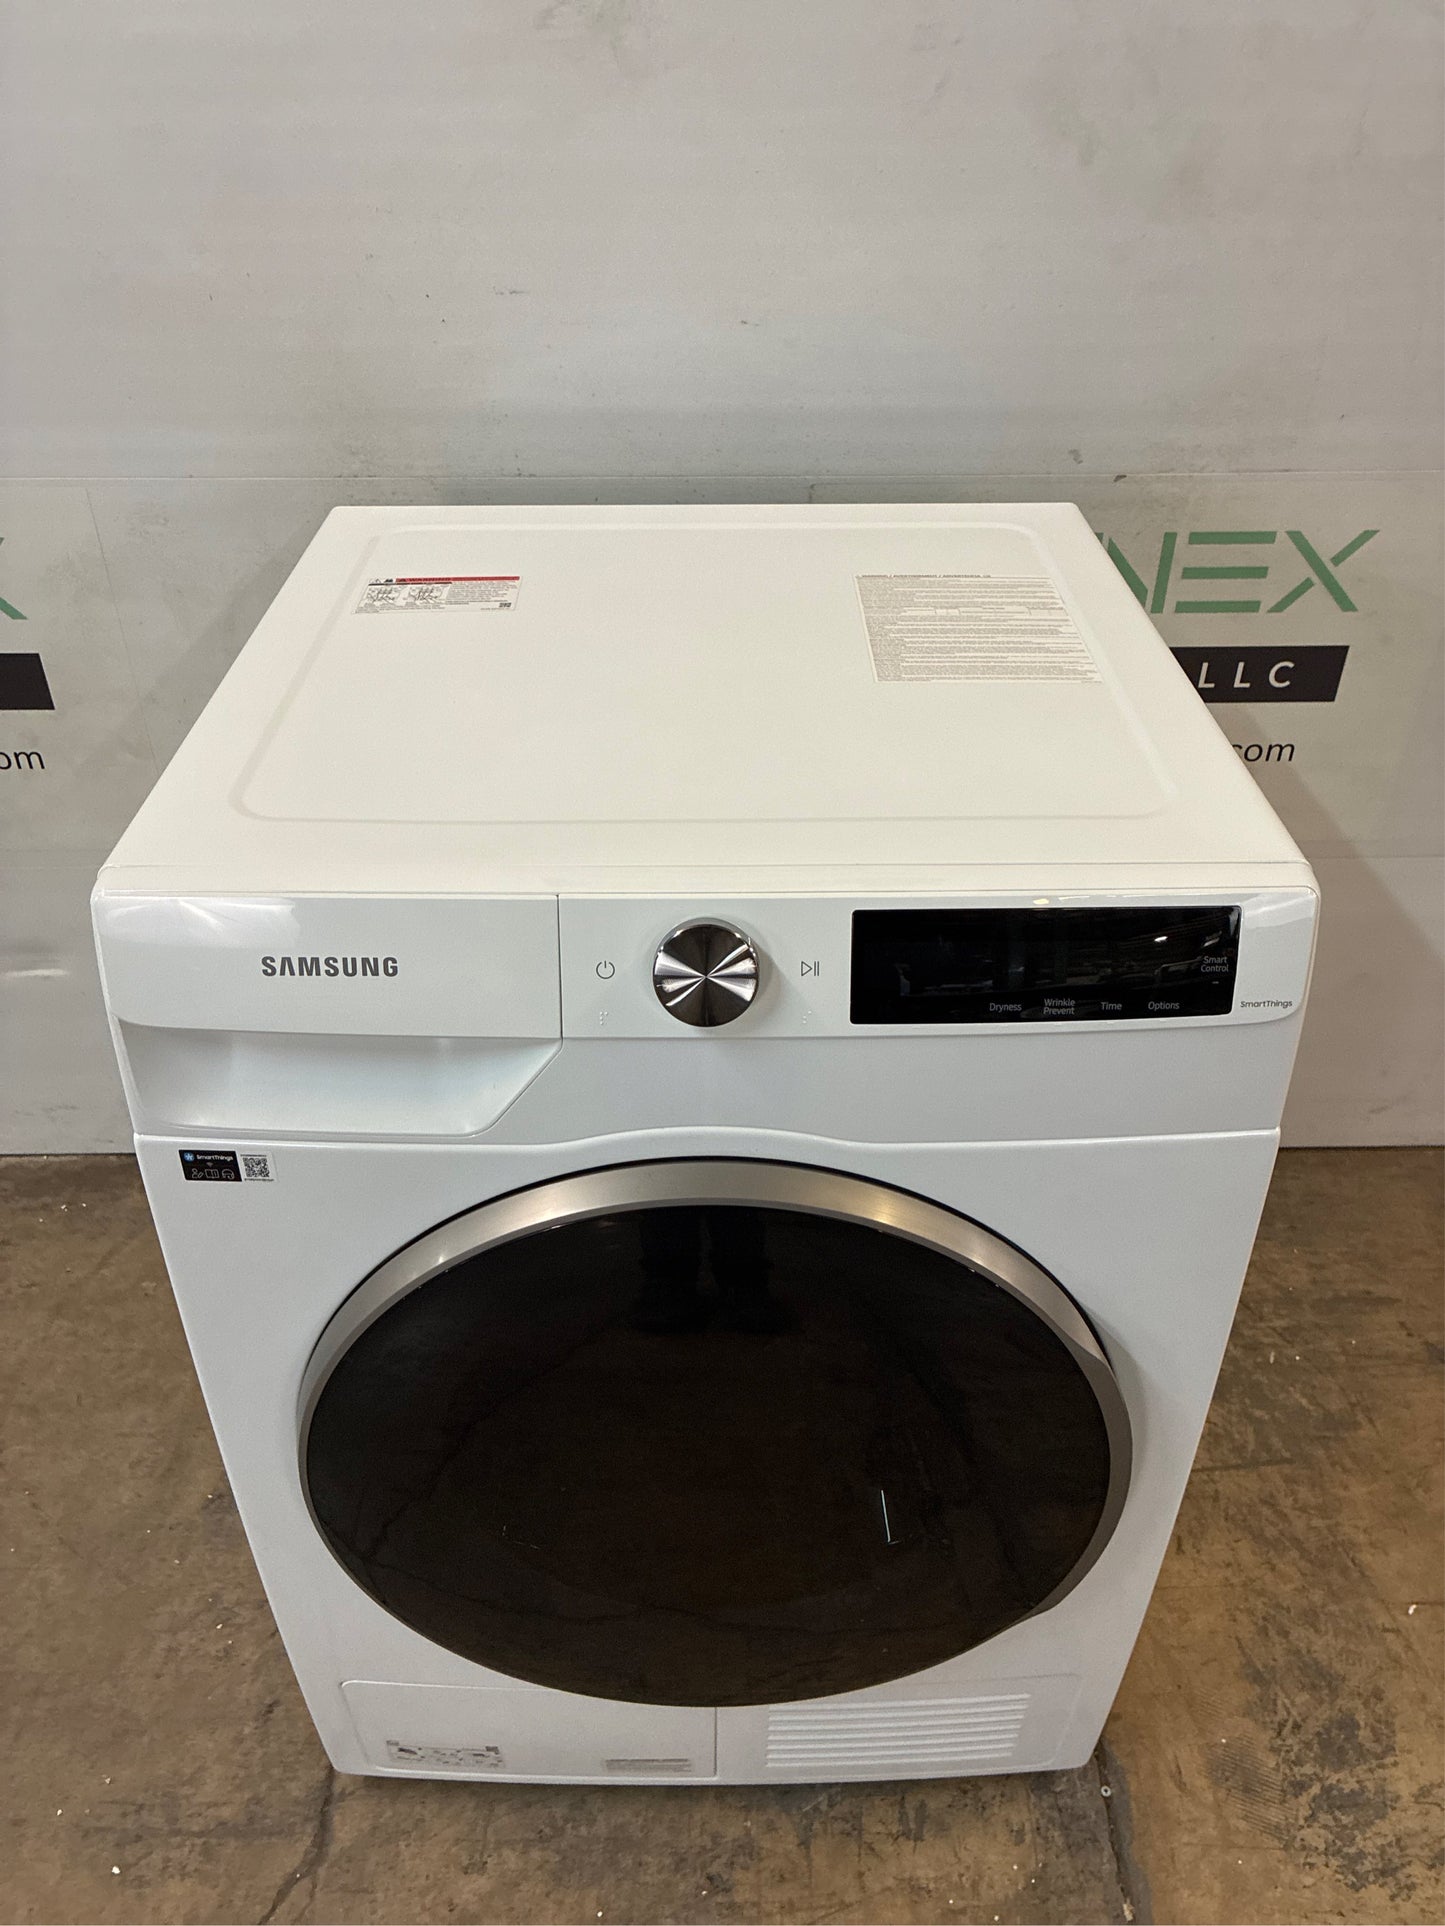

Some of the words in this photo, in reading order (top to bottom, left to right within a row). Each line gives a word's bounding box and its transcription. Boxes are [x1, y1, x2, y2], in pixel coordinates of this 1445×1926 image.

[1198, 661, 1295, 689] LLC
[1203, 955, 1228, 964] Smart
[261, 956, 398, 977] SAMSUNG
[1200, 964, 1229, 973] Control
[1043, 998, 1076, 1007] Wrinkle
[1100, 1001, 1123, 1011] Time
[1147, 1001, 1180, 1011] Options
[1240, 1000, 1293, 1009] SmartThings
[989, 1002, 1022, 1013] Dryness
[1043, 1006, 1075, 1015] Prevent
